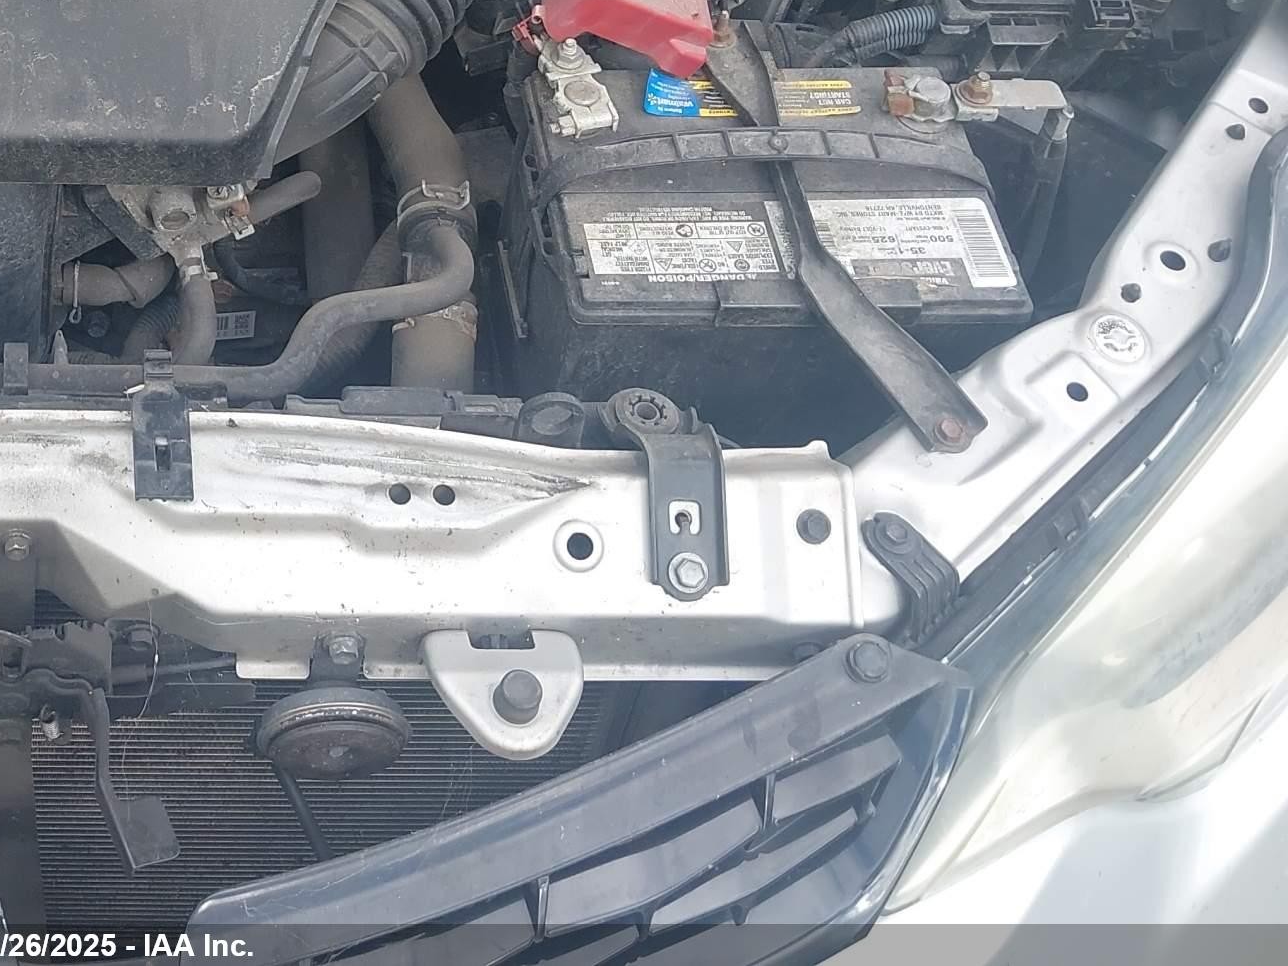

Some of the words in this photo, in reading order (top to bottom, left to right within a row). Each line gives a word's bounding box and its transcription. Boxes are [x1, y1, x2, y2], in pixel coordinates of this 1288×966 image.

[656, 97, 694, 107] Walmart
[871, 235, 895, 243] 625
[929, 234, 954, 242] 500
[647, 273, 746, 283] DANGER/POISON
